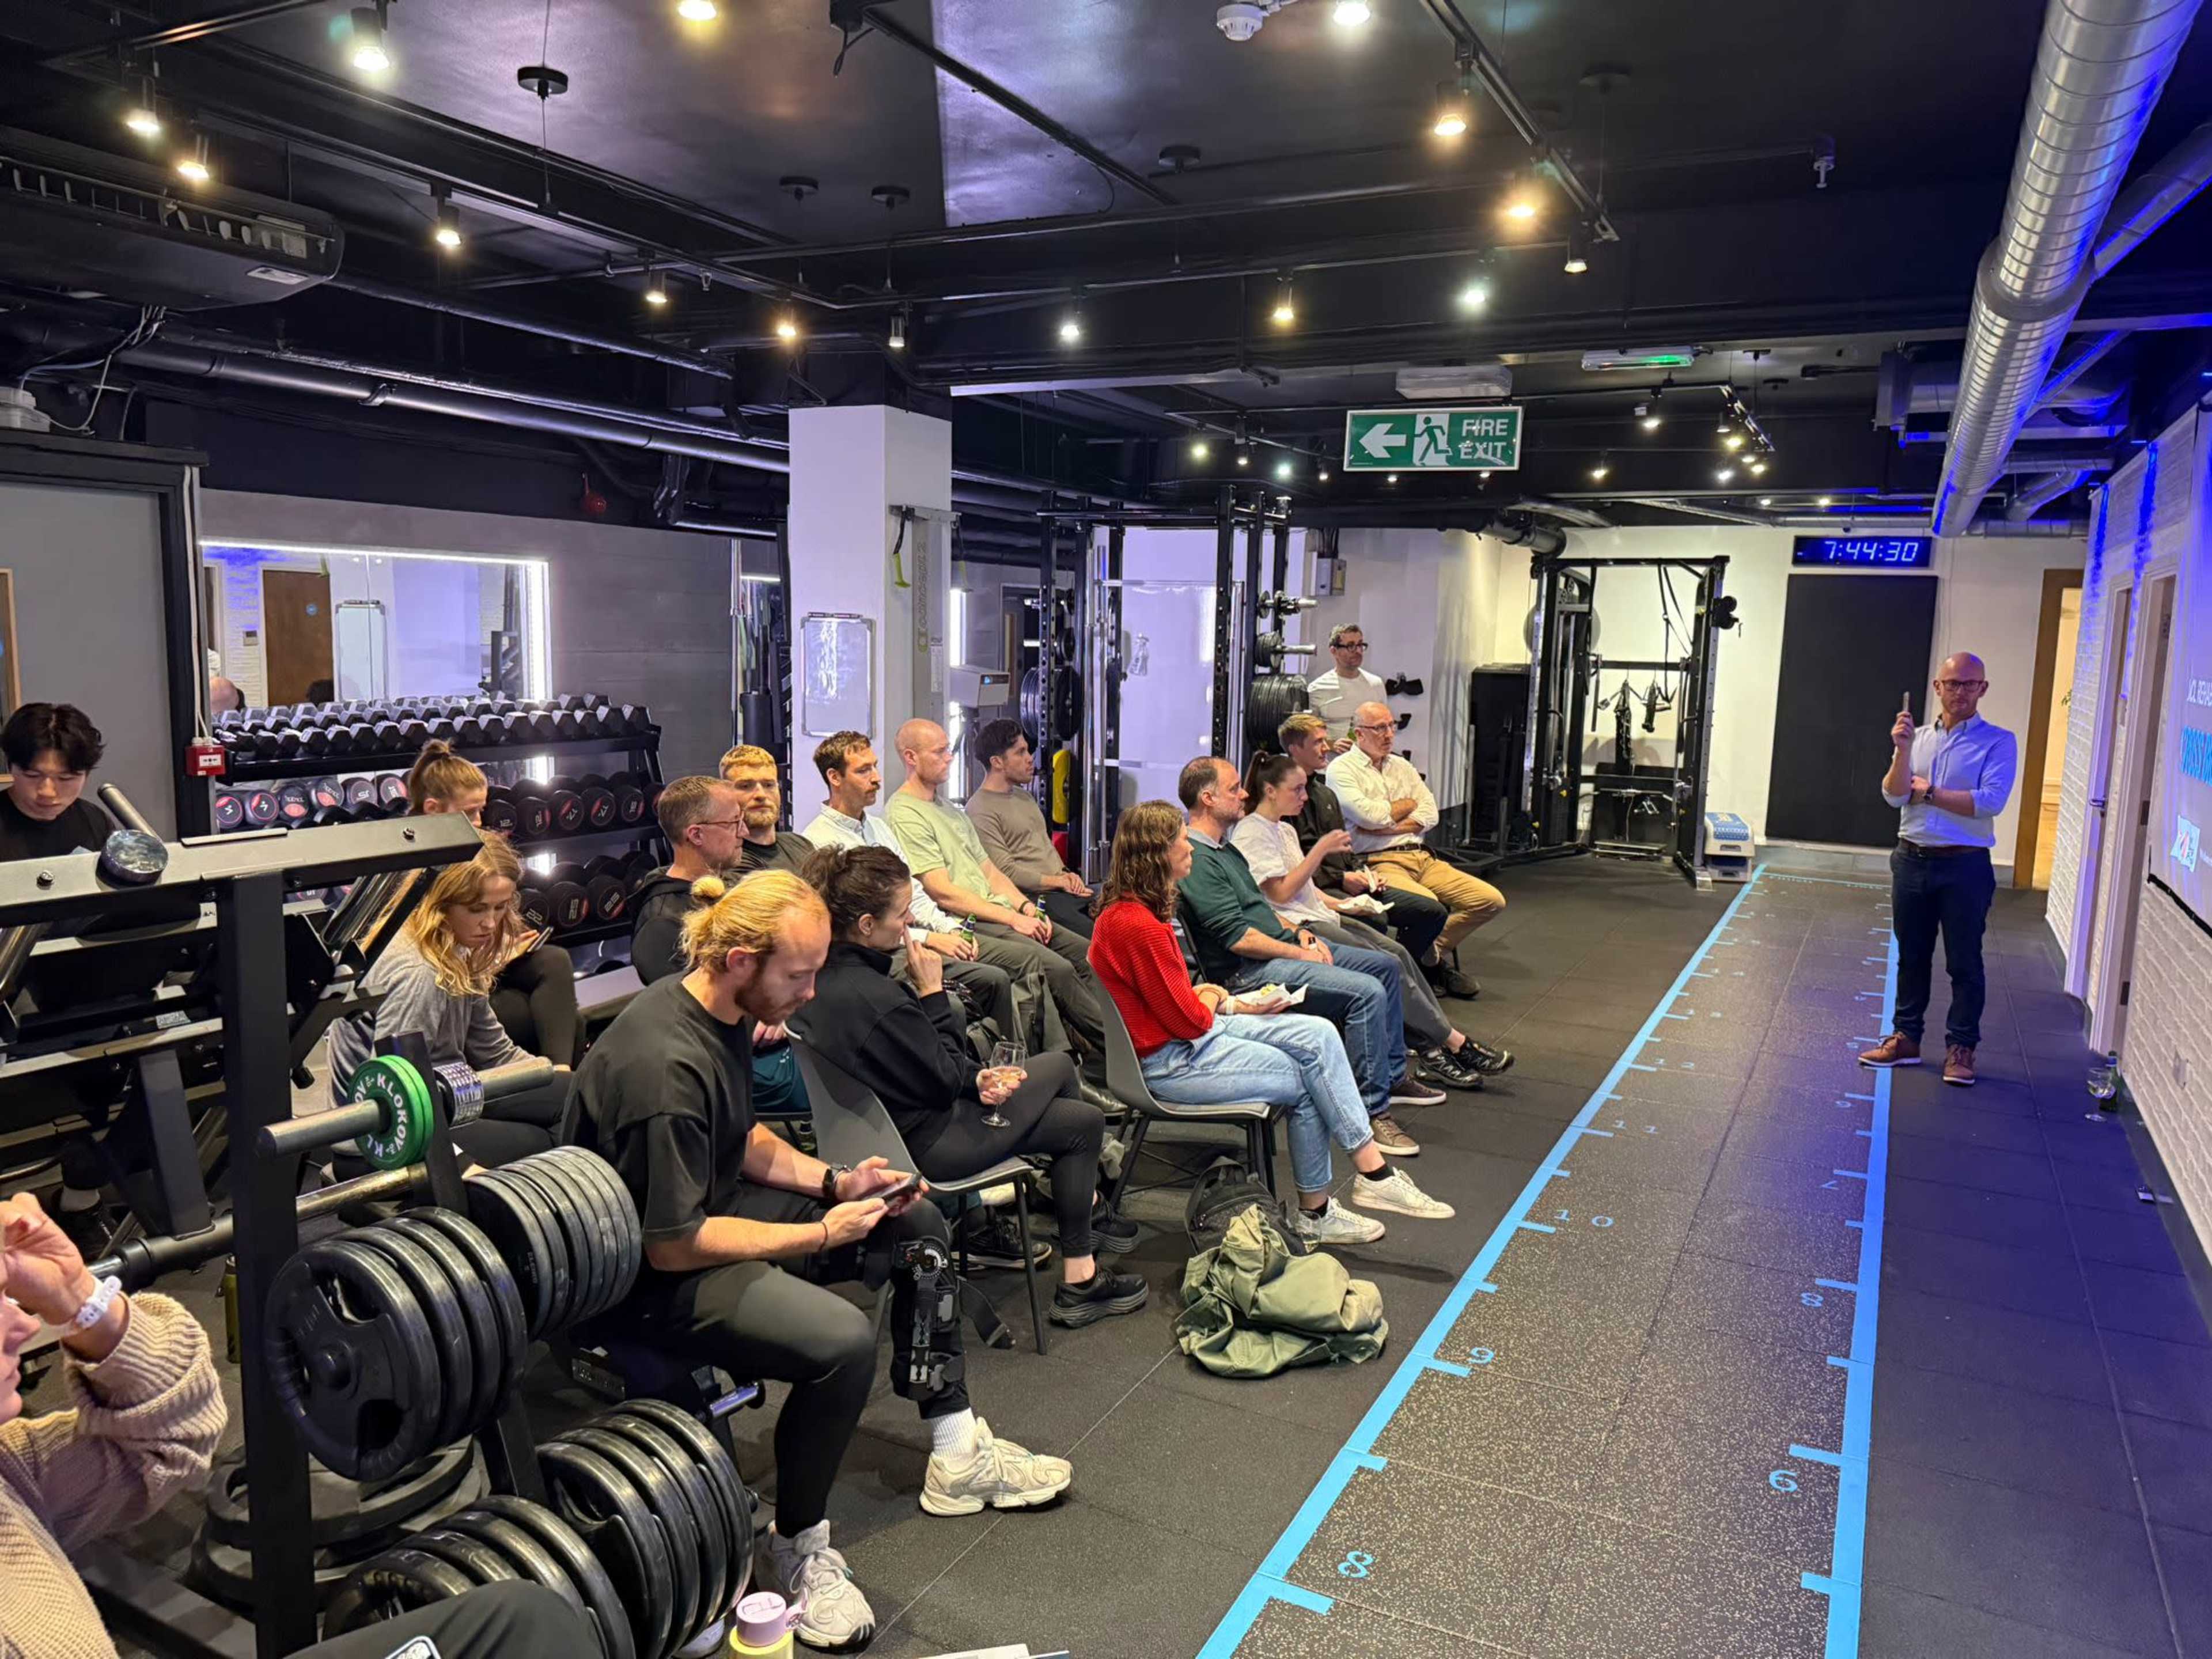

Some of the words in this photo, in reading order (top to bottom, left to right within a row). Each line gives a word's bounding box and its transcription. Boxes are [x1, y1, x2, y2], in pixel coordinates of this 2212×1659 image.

[1462, 419, 1509, 437] FIRE
[1460, 442, 1506, 460] EXIT
[1824, 541, 1919, 562] 7:44:30
[377, 1073, 408, 1152] KLOKOV
[1800, 1291, 1824, 1308] 8
[1338, 1550, 1374, 1579] 8
